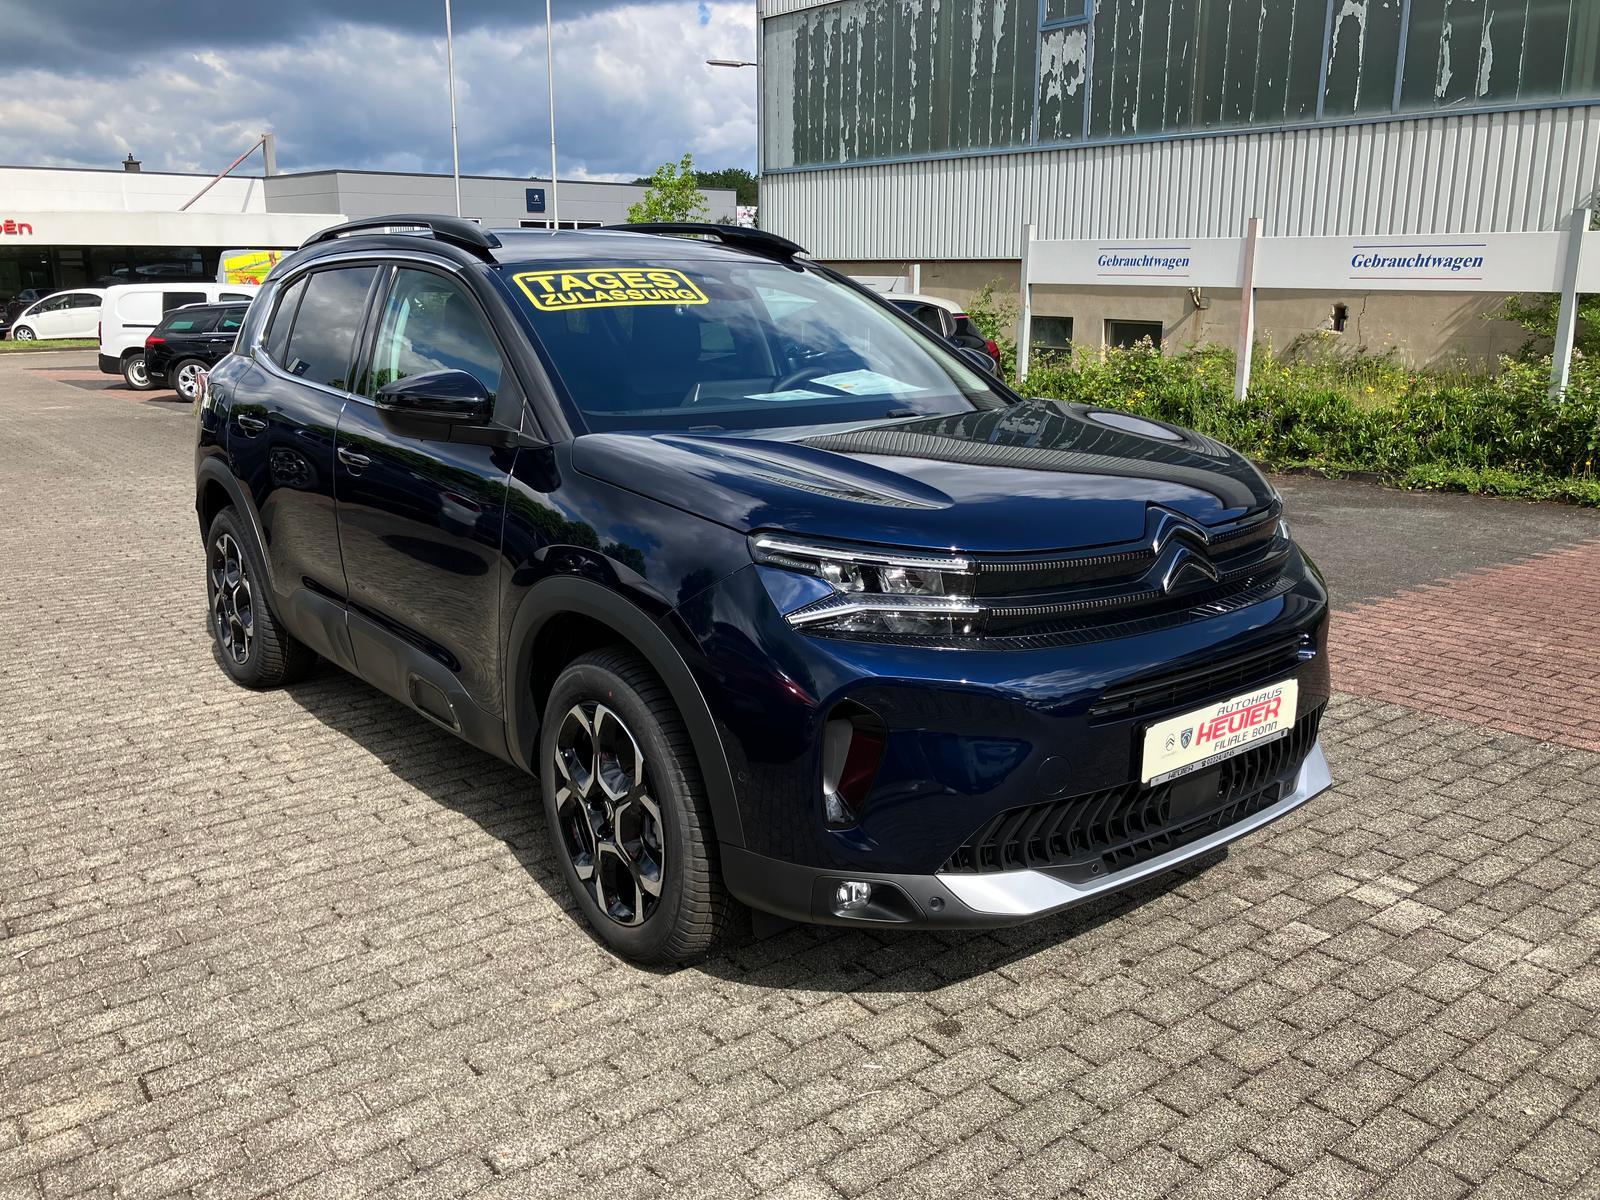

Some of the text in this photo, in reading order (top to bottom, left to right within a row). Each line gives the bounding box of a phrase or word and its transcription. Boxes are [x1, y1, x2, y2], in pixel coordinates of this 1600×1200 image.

[1098, 254, 1190, 270] Gebrauchtwagen
[1351, 253, 1484, 272] Gebrauchtwagen
[525, 272, 680, 293] TAGES
[540, 288, 698, 306] ZULASSUNG
[1217, 687, 1283, 717] AUTOHAUS
[1196, 696, 1282, 746] HEUTER
[1214, 730, 1249, 752] FILIALE
